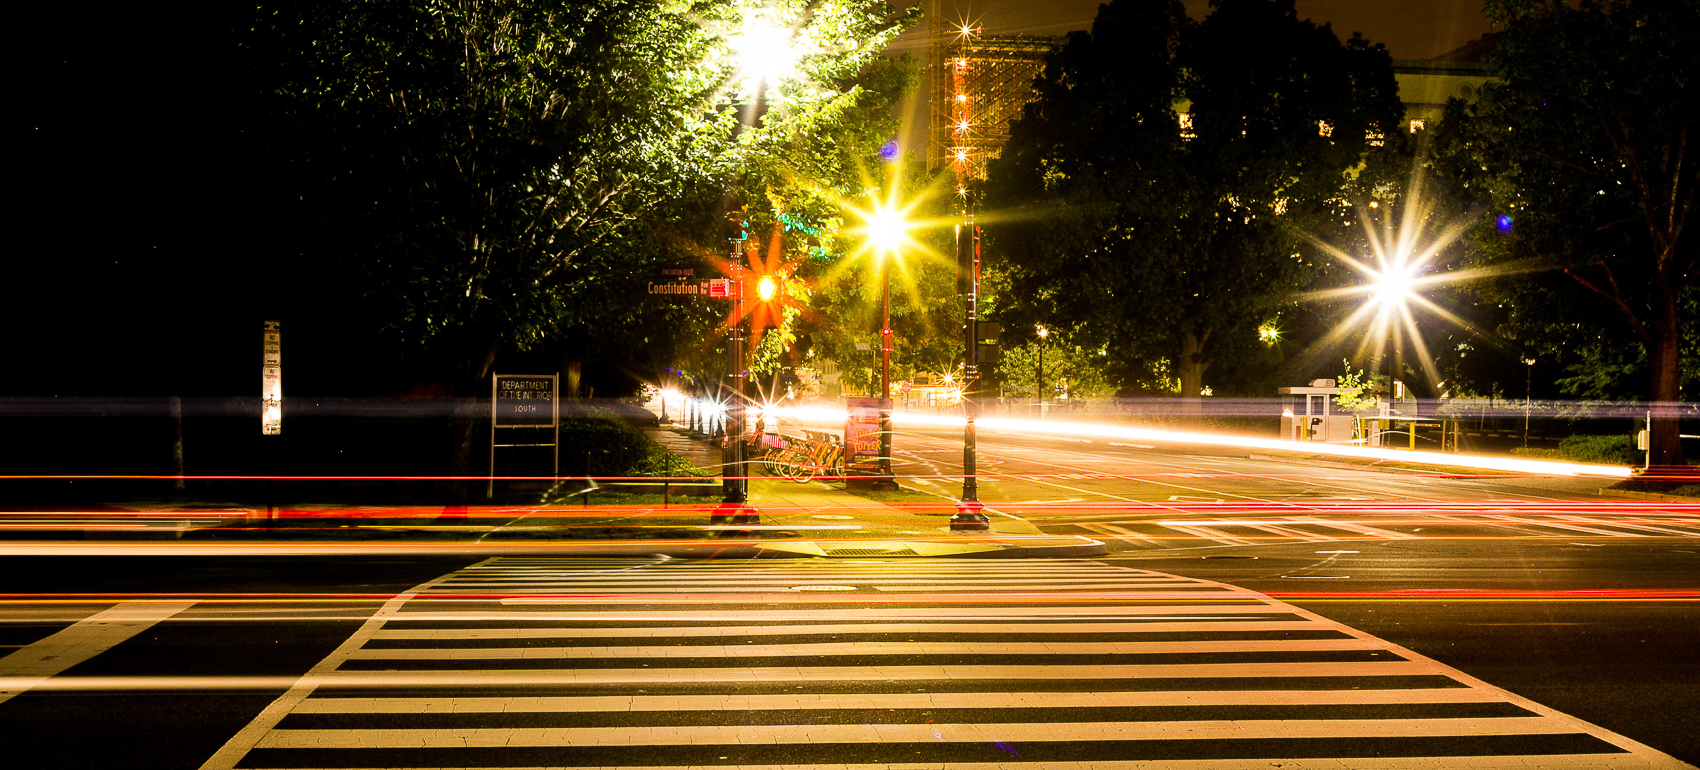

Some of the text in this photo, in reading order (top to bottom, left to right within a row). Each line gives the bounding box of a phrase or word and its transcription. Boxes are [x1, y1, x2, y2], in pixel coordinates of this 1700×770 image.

[683, 268, 694, 276] ROUTE
[648, 281, 698, 295] Constitution
[502, 380, 549, 390] DEPARTMENT
[498, 390, 553, 400] OF THE INTRIOR
[514, 405, 536, 413] SOUTH
[853, 438, 882, 454] POTTER
